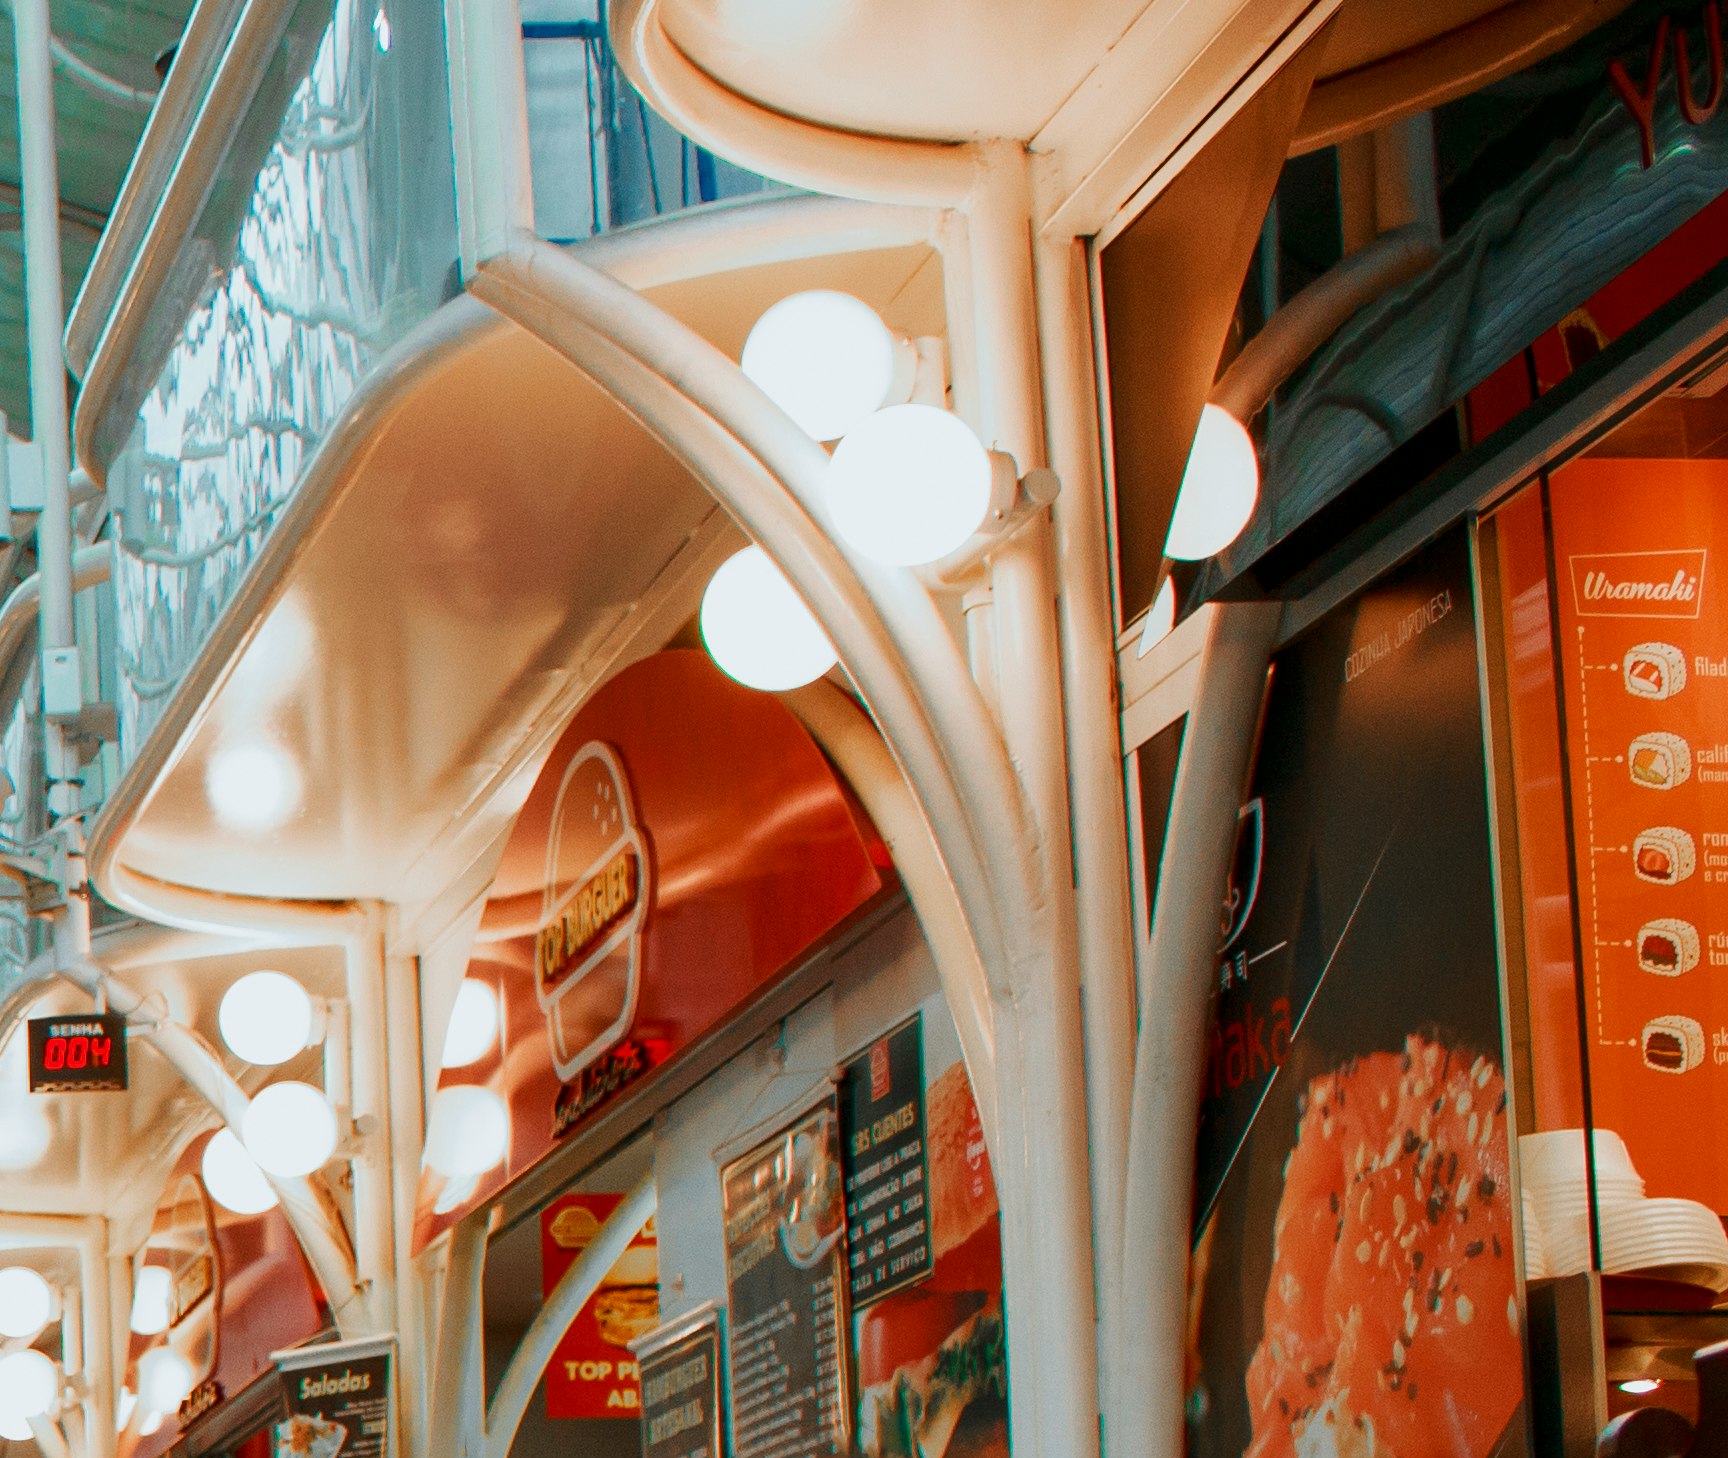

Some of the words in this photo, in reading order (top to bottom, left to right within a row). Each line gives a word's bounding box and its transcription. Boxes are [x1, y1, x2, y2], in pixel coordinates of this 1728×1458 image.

[1609, 0, 1728, 170] YU
[1583, 568, 1697, 602] Uramaki
[49, 1022, 104, 1038] SENHA
[44, 1036, 112, 1071] 004
[299, 1368, 373, 1401] Saladas
[564, 1360, 613, 1382] TOP
